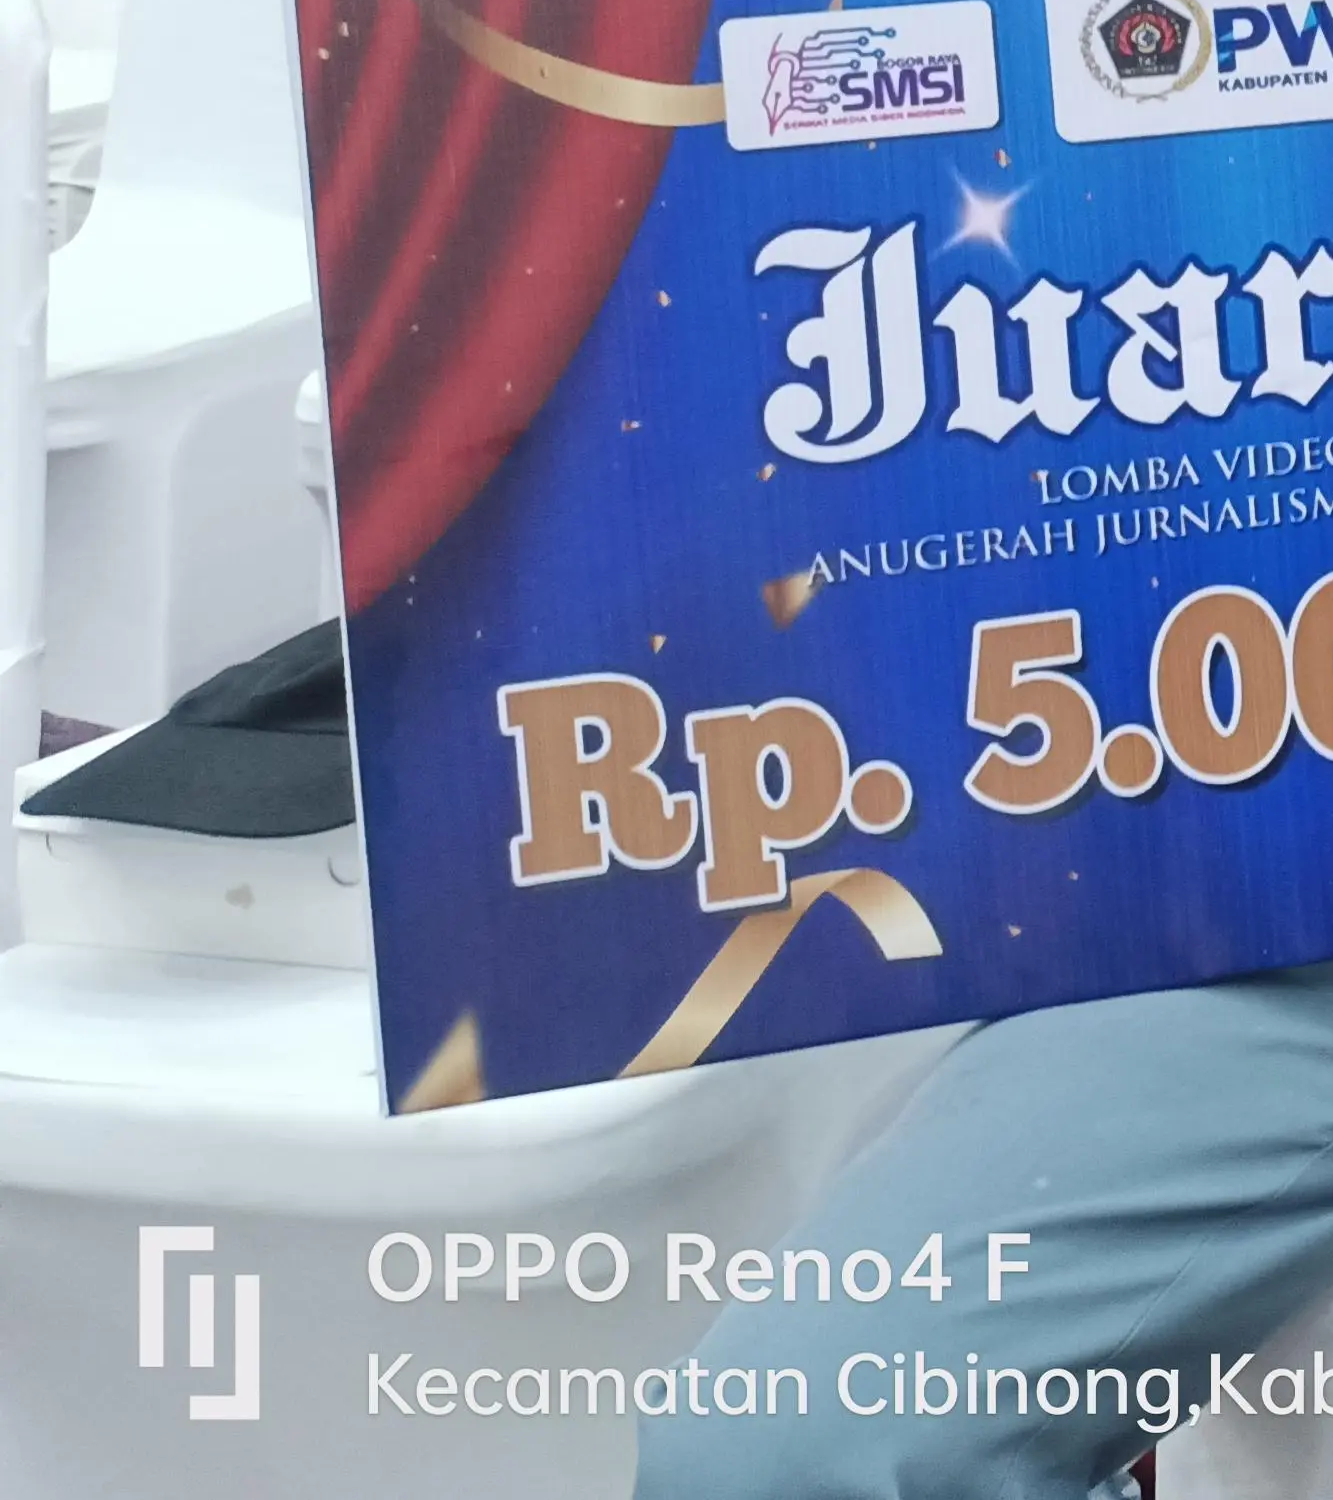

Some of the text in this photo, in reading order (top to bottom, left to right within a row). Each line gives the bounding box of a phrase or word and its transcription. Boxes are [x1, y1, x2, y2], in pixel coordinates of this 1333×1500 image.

[838, 63, 966, 113] SMSI
[1218, 70, 1329, 93] KABUPATEN
[1039, 457, 1202, 506] LOMBA
[805, 512, 1077, 588] ANUGERAH
[497, 672, 914, 916] Rp.
